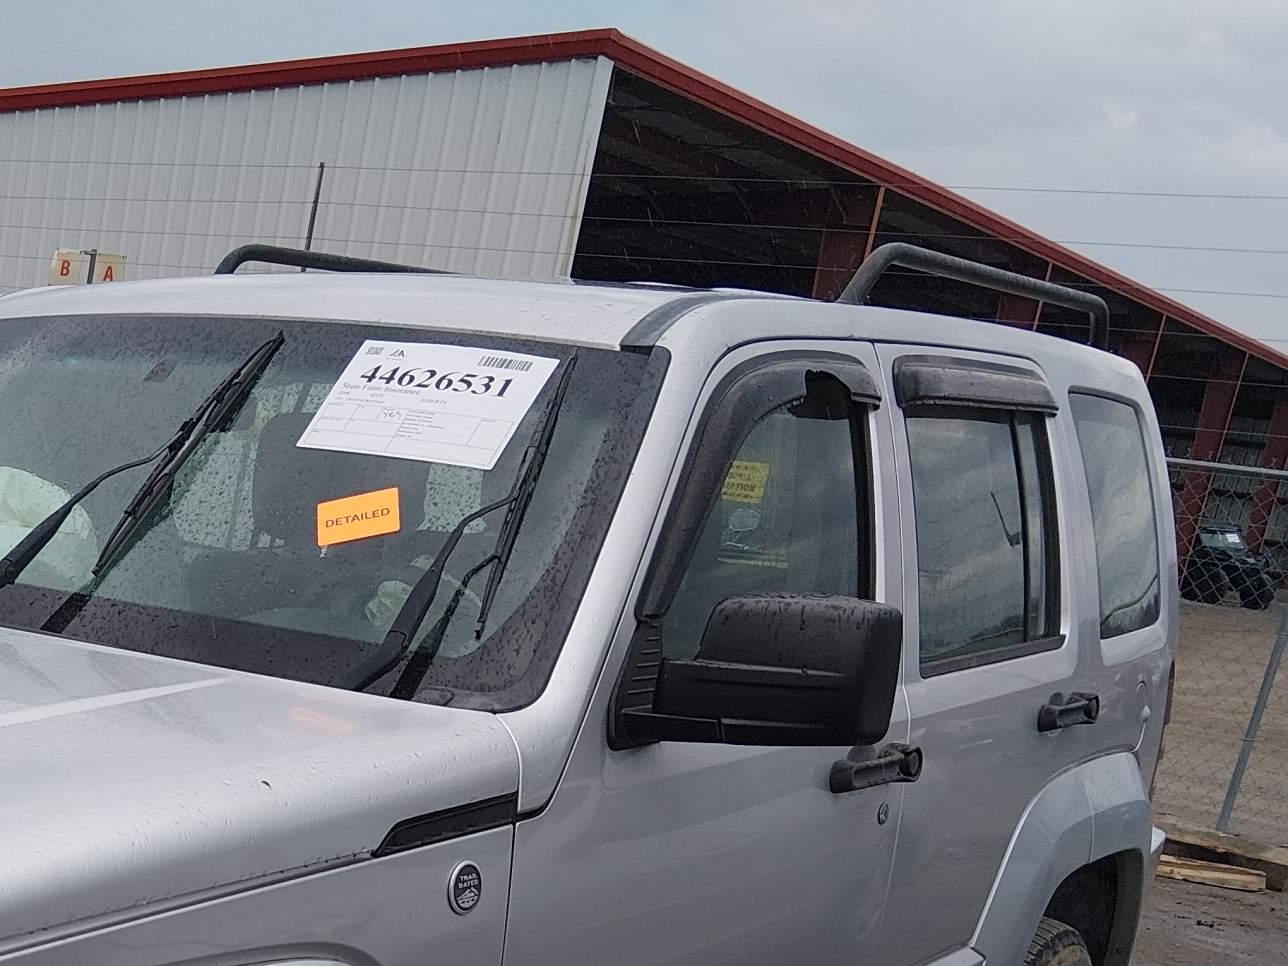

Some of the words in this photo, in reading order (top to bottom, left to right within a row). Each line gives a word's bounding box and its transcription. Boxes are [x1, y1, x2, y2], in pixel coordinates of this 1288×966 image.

[60, 260, 71, 276] B
[103, 266, 114, 281] A
[360, 364, 515, 398] 44626531
[324, 507, 391, 529] DETAILED
